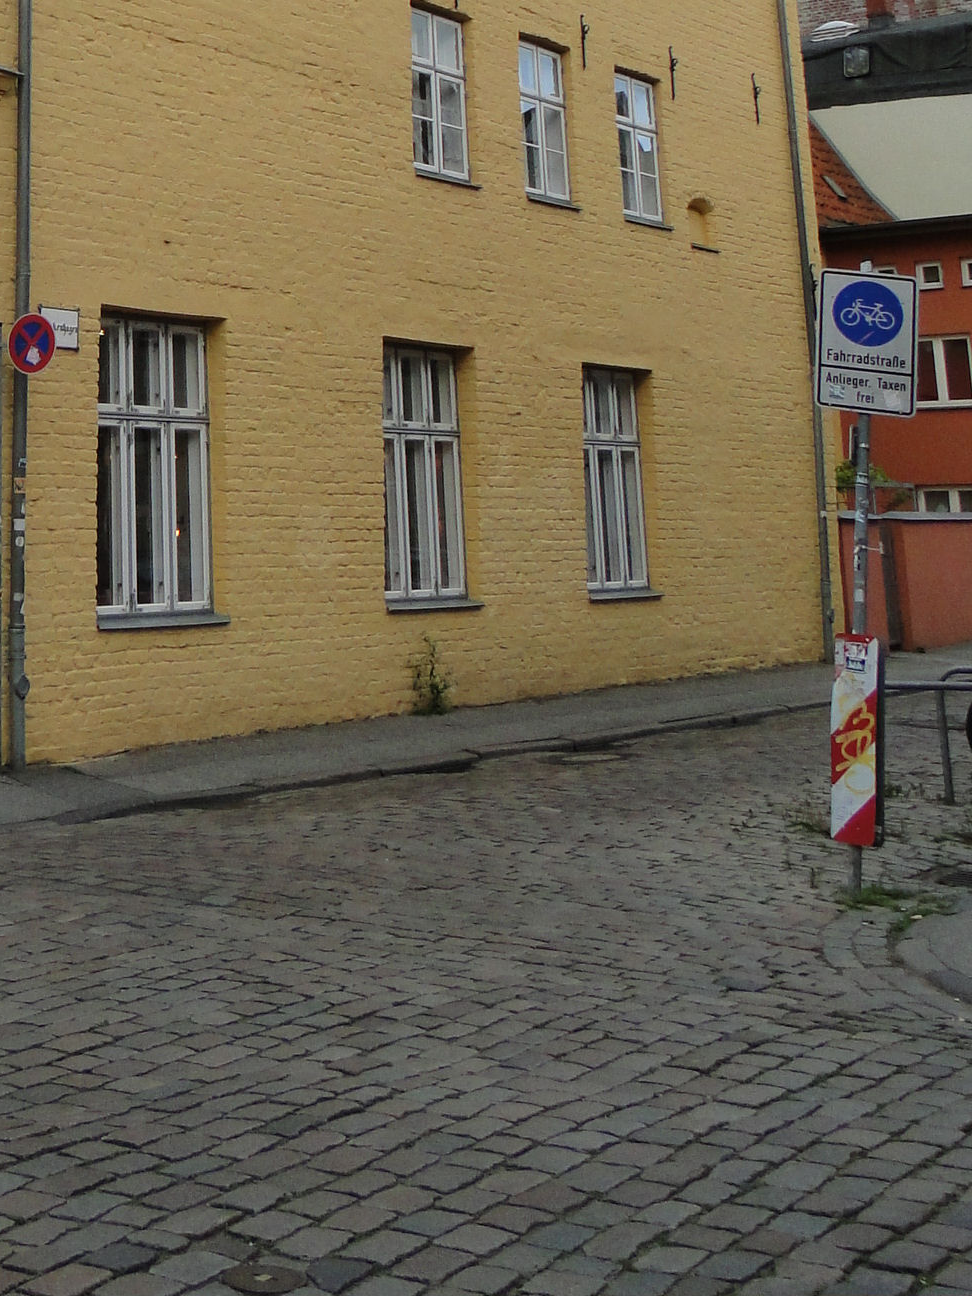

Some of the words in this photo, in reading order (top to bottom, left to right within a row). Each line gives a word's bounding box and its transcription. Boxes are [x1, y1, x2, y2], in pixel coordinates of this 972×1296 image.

[827, 348, 906, 368] Fahrradstraße
[877, 377, 906, 392] Taxen
[857, 391, 875, 403] frei
